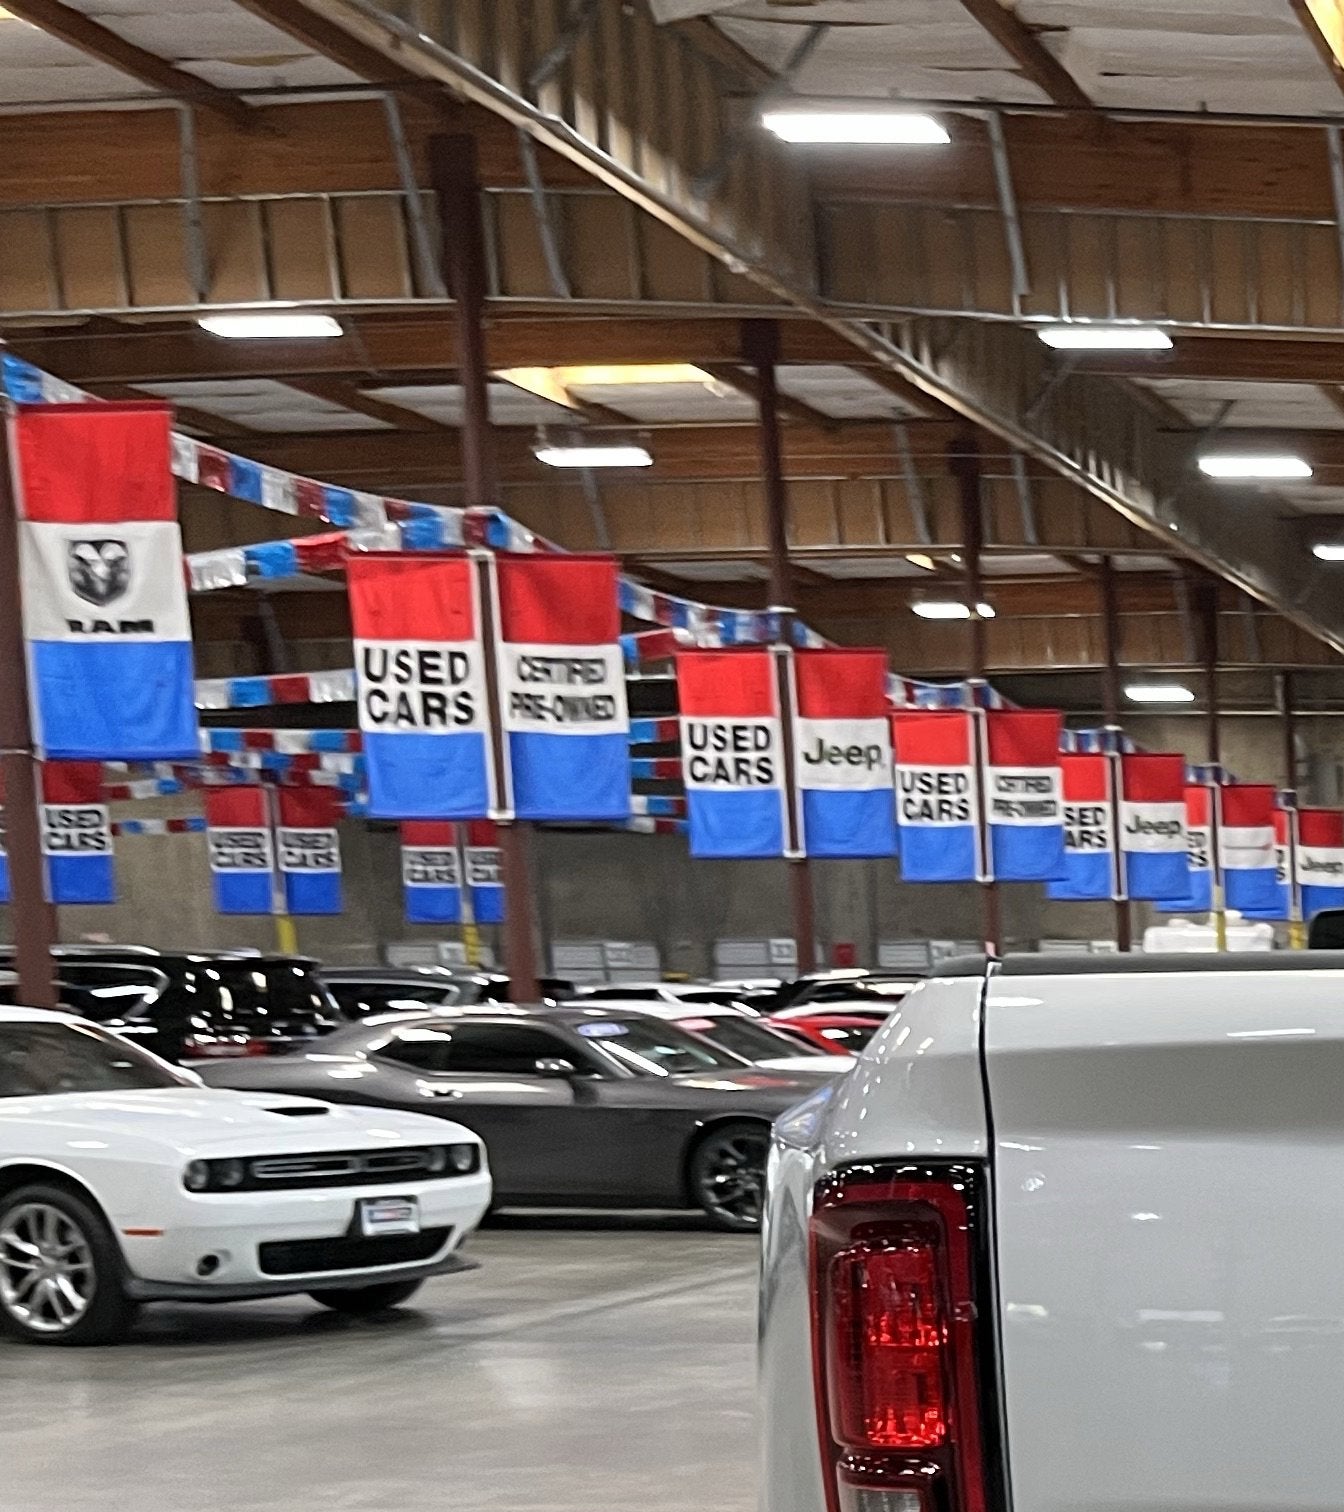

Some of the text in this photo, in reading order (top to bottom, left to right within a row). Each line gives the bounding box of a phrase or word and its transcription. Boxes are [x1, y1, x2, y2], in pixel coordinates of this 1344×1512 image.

[364, 648, 470, 685] USED
[366, 688, 474, 727] CARS
[688, 723, 770, 752] USED
[803, 738, 882, 770] Jeep
[689, 756, 773, 784] CARS
[900, 771, 970, 795] USED
[902, 798, 970, 821] CARS
[1064, 806, 1106, 825] SED
[1064, 829, 1107, 849] ARS
[1126, 815, 1182, 838] Jeep
